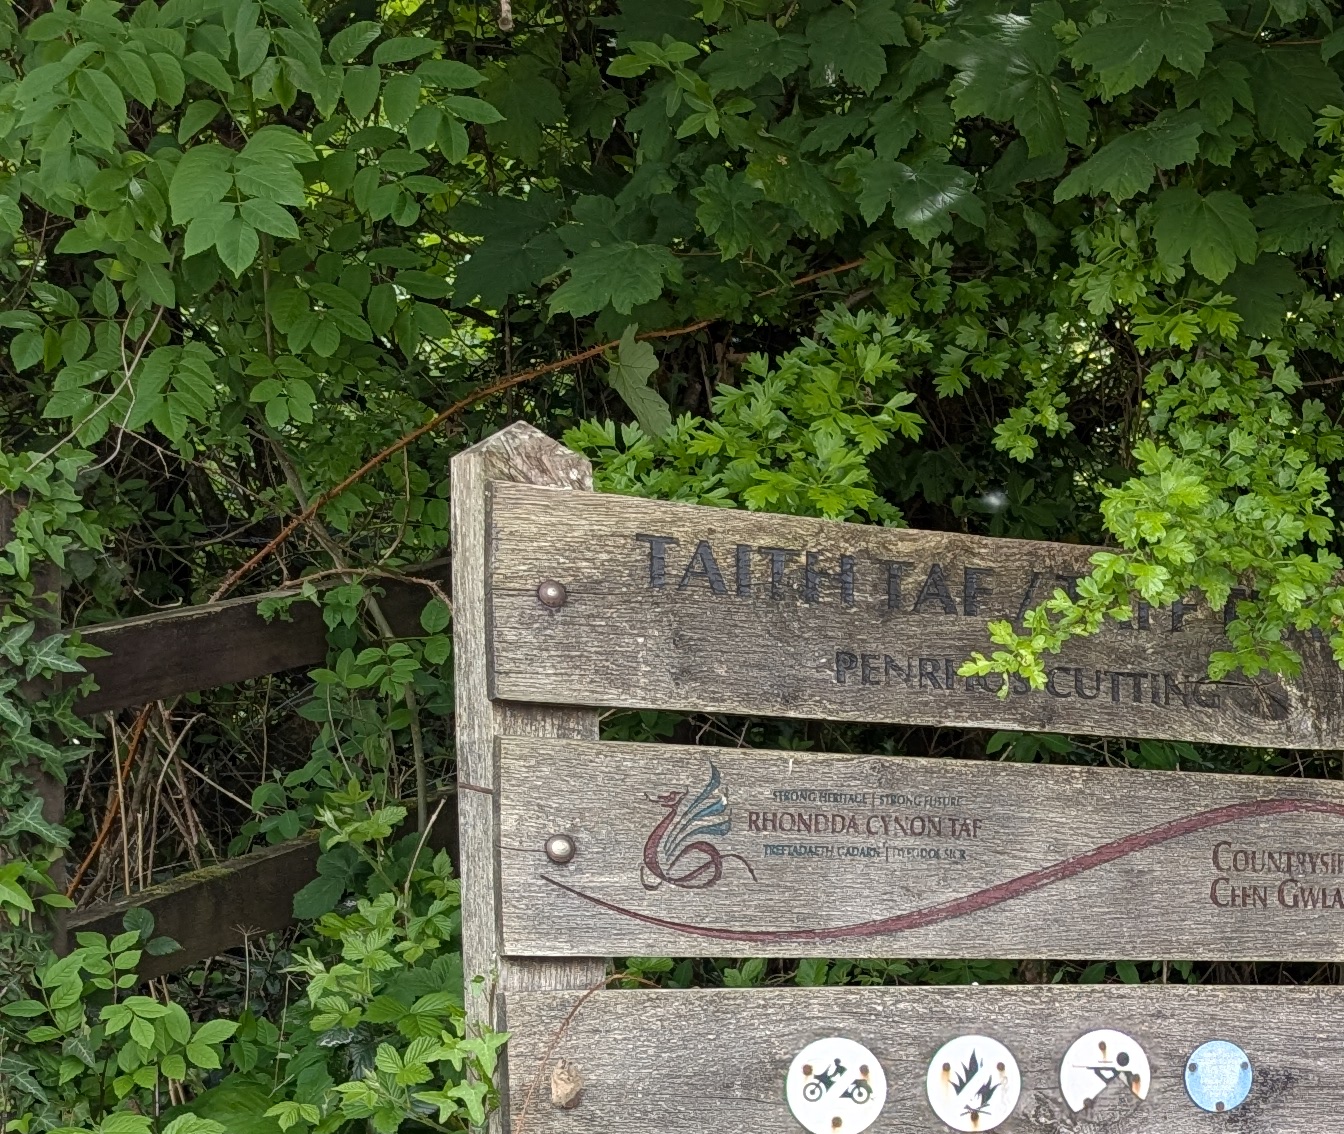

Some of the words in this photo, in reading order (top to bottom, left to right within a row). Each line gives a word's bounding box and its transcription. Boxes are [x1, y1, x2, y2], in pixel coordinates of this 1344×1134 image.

[636, 533, 855, 604] TAITH
[880, 560, 994, 617] TAF
[1047, 666, 1222, 709] CUTTING
[773, 789, 817, 803] STRONG
[819, 791, 868, 805] HERITAGE
[880, 794, 921, 807] STRONG
[924, 796, 962, 808] FUTURE
[748, 811, 859, 833] RHONDDA
[866, 815, 942, 837] CYNON
[948, 818, 982, 838] TAF
